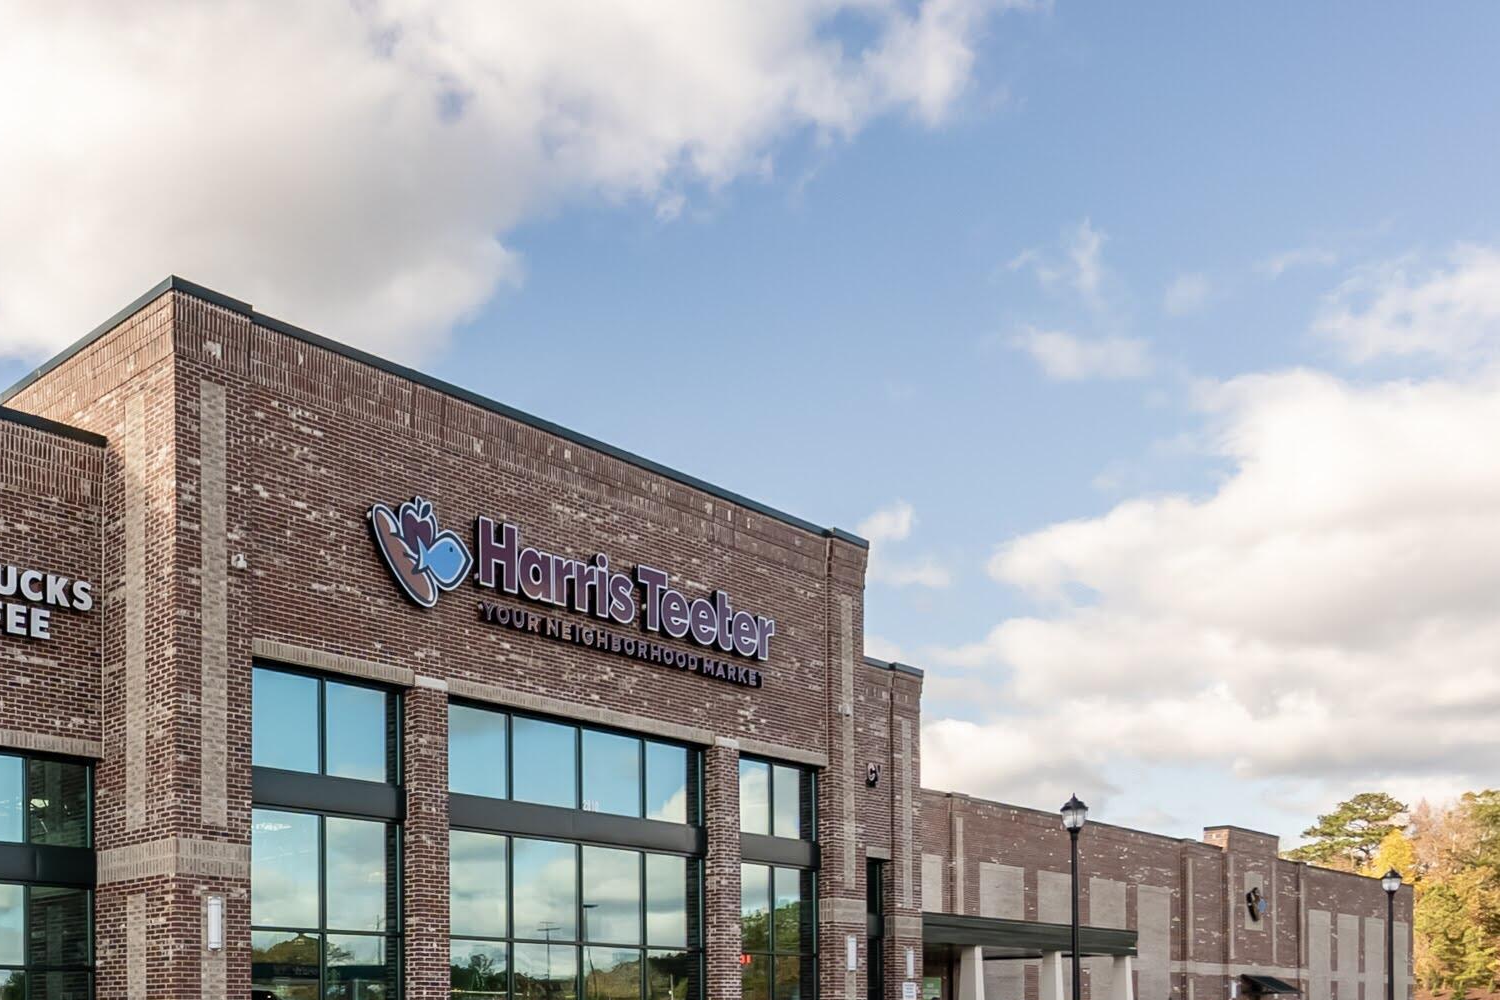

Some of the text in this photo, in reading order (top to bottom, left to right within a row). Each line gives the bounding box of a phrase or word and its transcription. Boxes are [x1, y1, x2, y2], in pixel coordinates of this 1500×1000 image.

[478, 515, 775, 660] Harris Teeter
[483, 600, 765, 689] YOUR NEIGHBORHOOD MARKET
